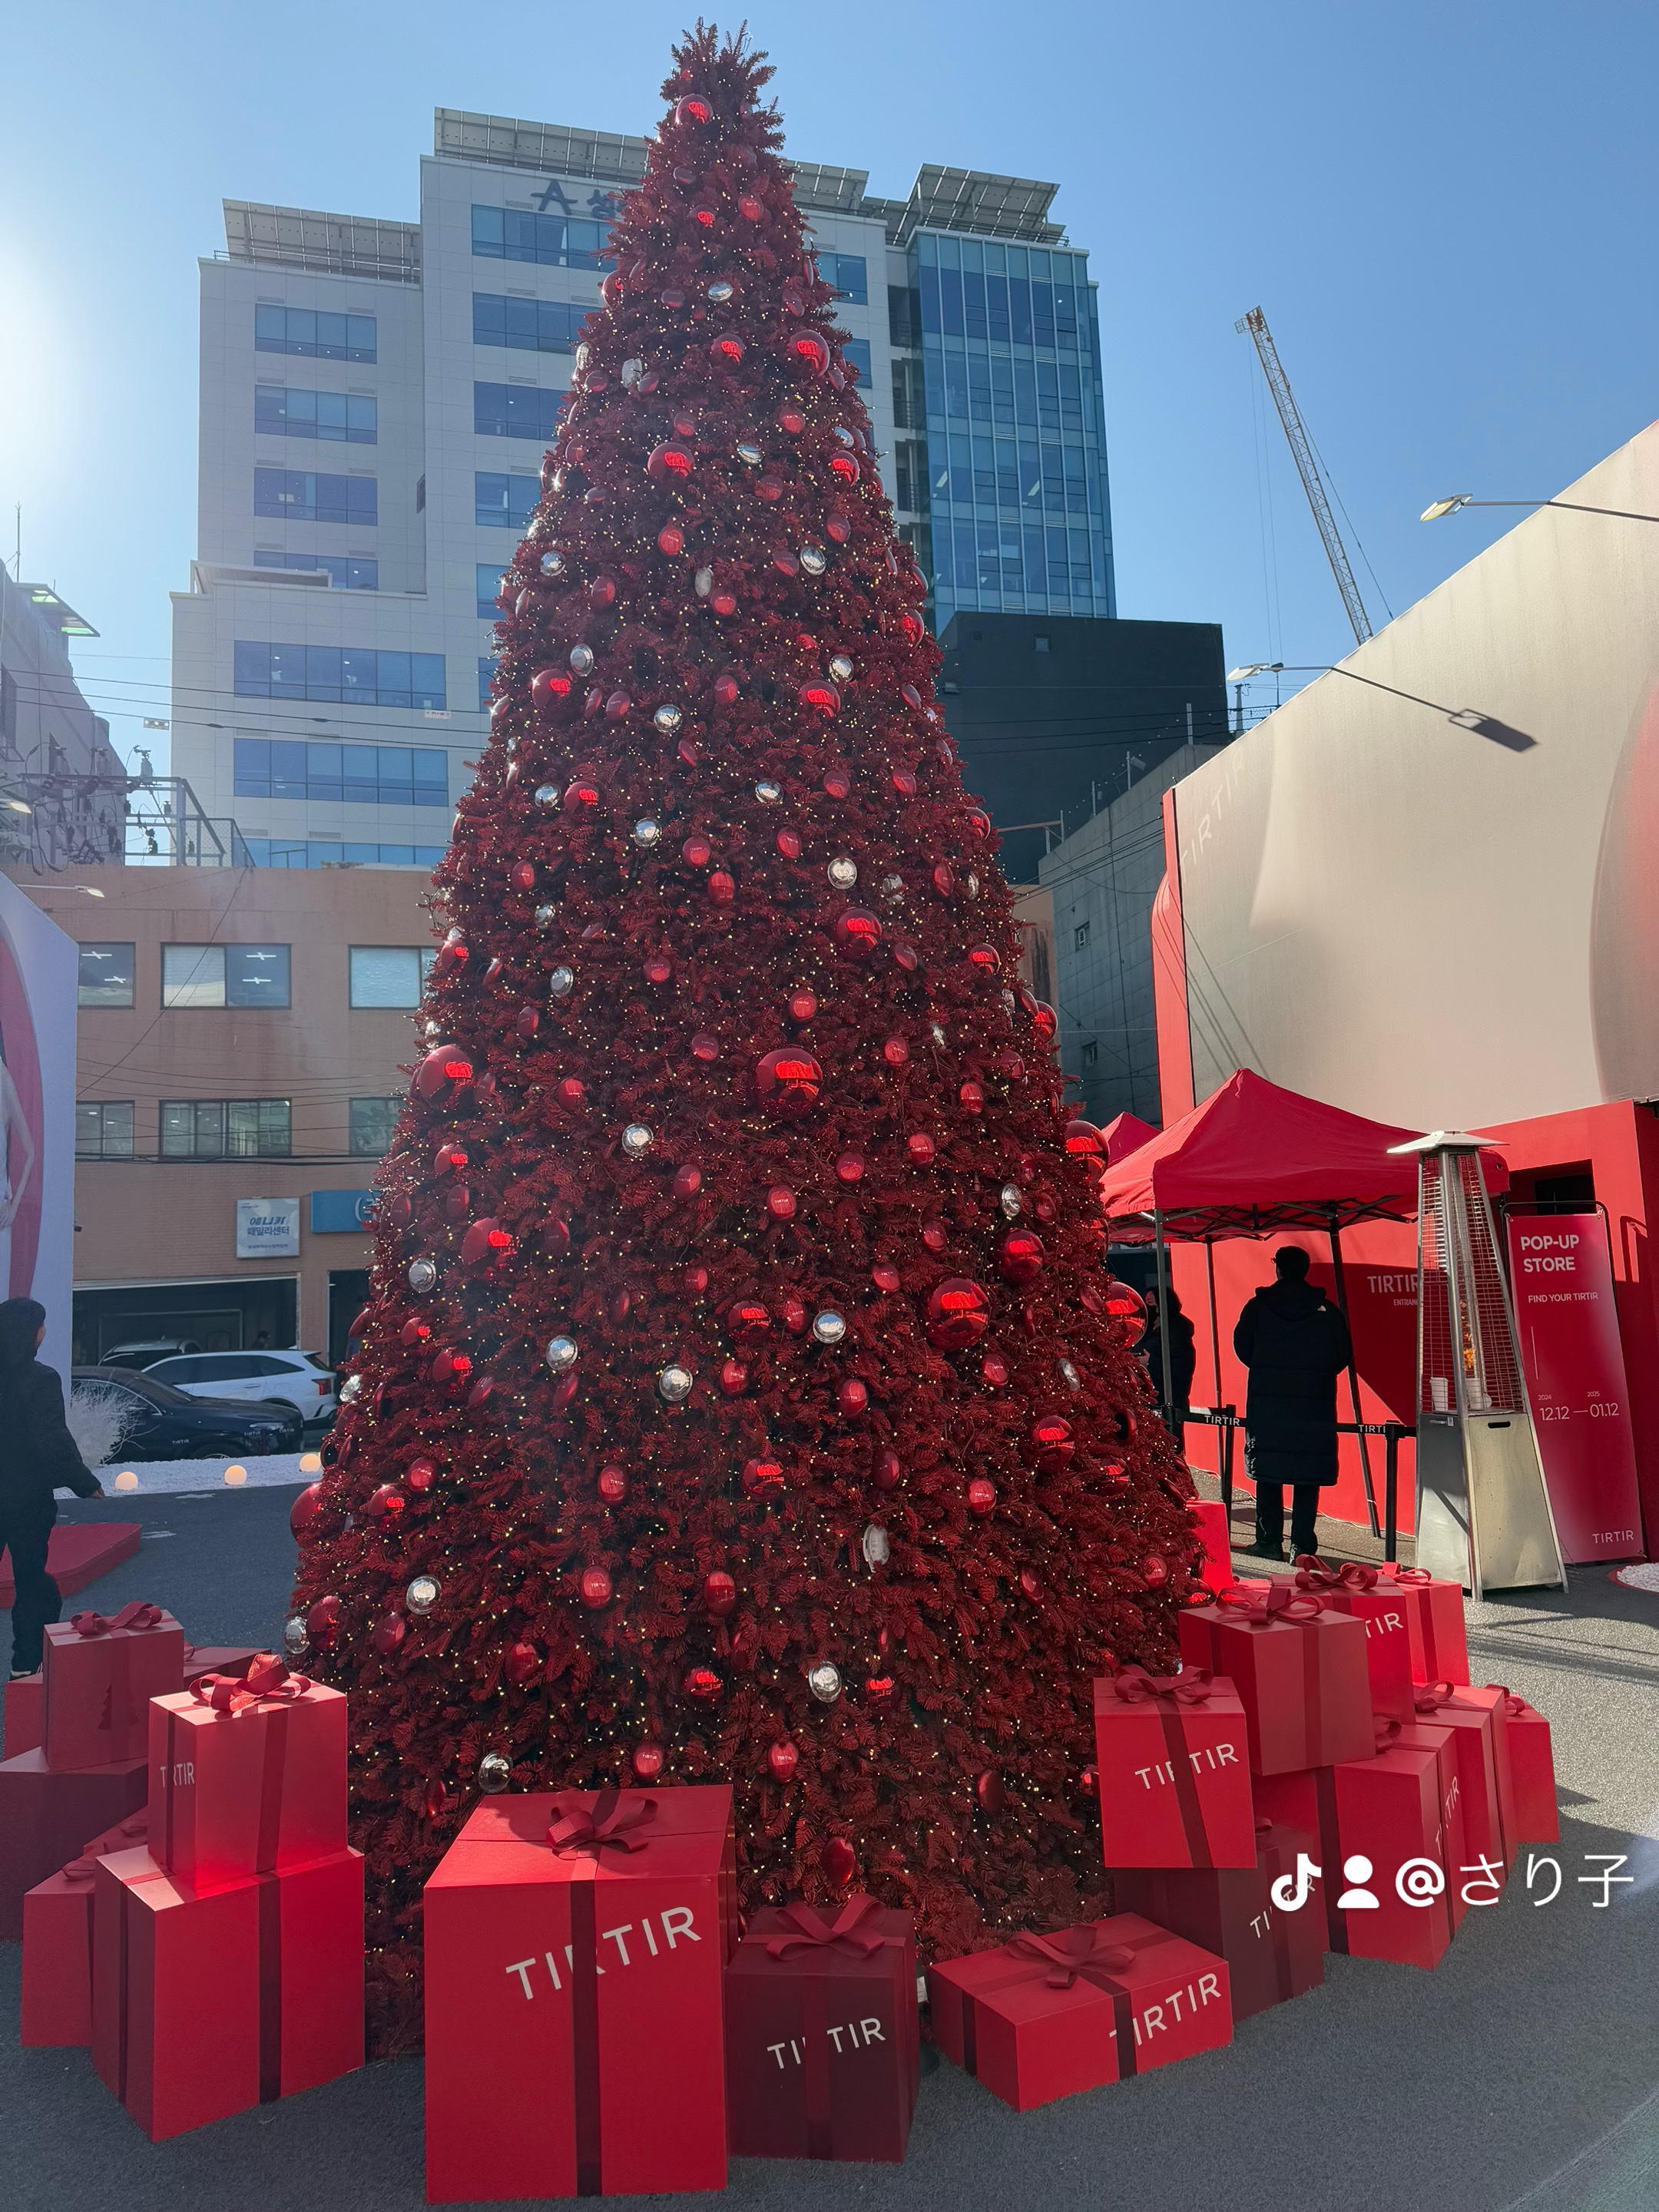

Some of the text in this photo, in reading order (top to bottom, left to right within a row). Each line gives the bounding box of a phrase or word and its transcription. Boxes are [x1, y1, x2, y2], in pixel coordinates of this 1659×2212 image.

[1520, 1234, 1579, 1250] POP-UP
[1523, 1257, 1576, 1273] STORE
[1528, 1292, 1598, 1303] FIND YOUR TIRTIR
[1204, 1415, 1240, 1426] TIRTIR
[1592, 1530, 1634, 1544] TIRTIR
[160, 1762, 195, 1789] TTIR
[1109, 1972, 1221, 2046] IRTIR
[767, 2018, 886, 2069] TITIR
